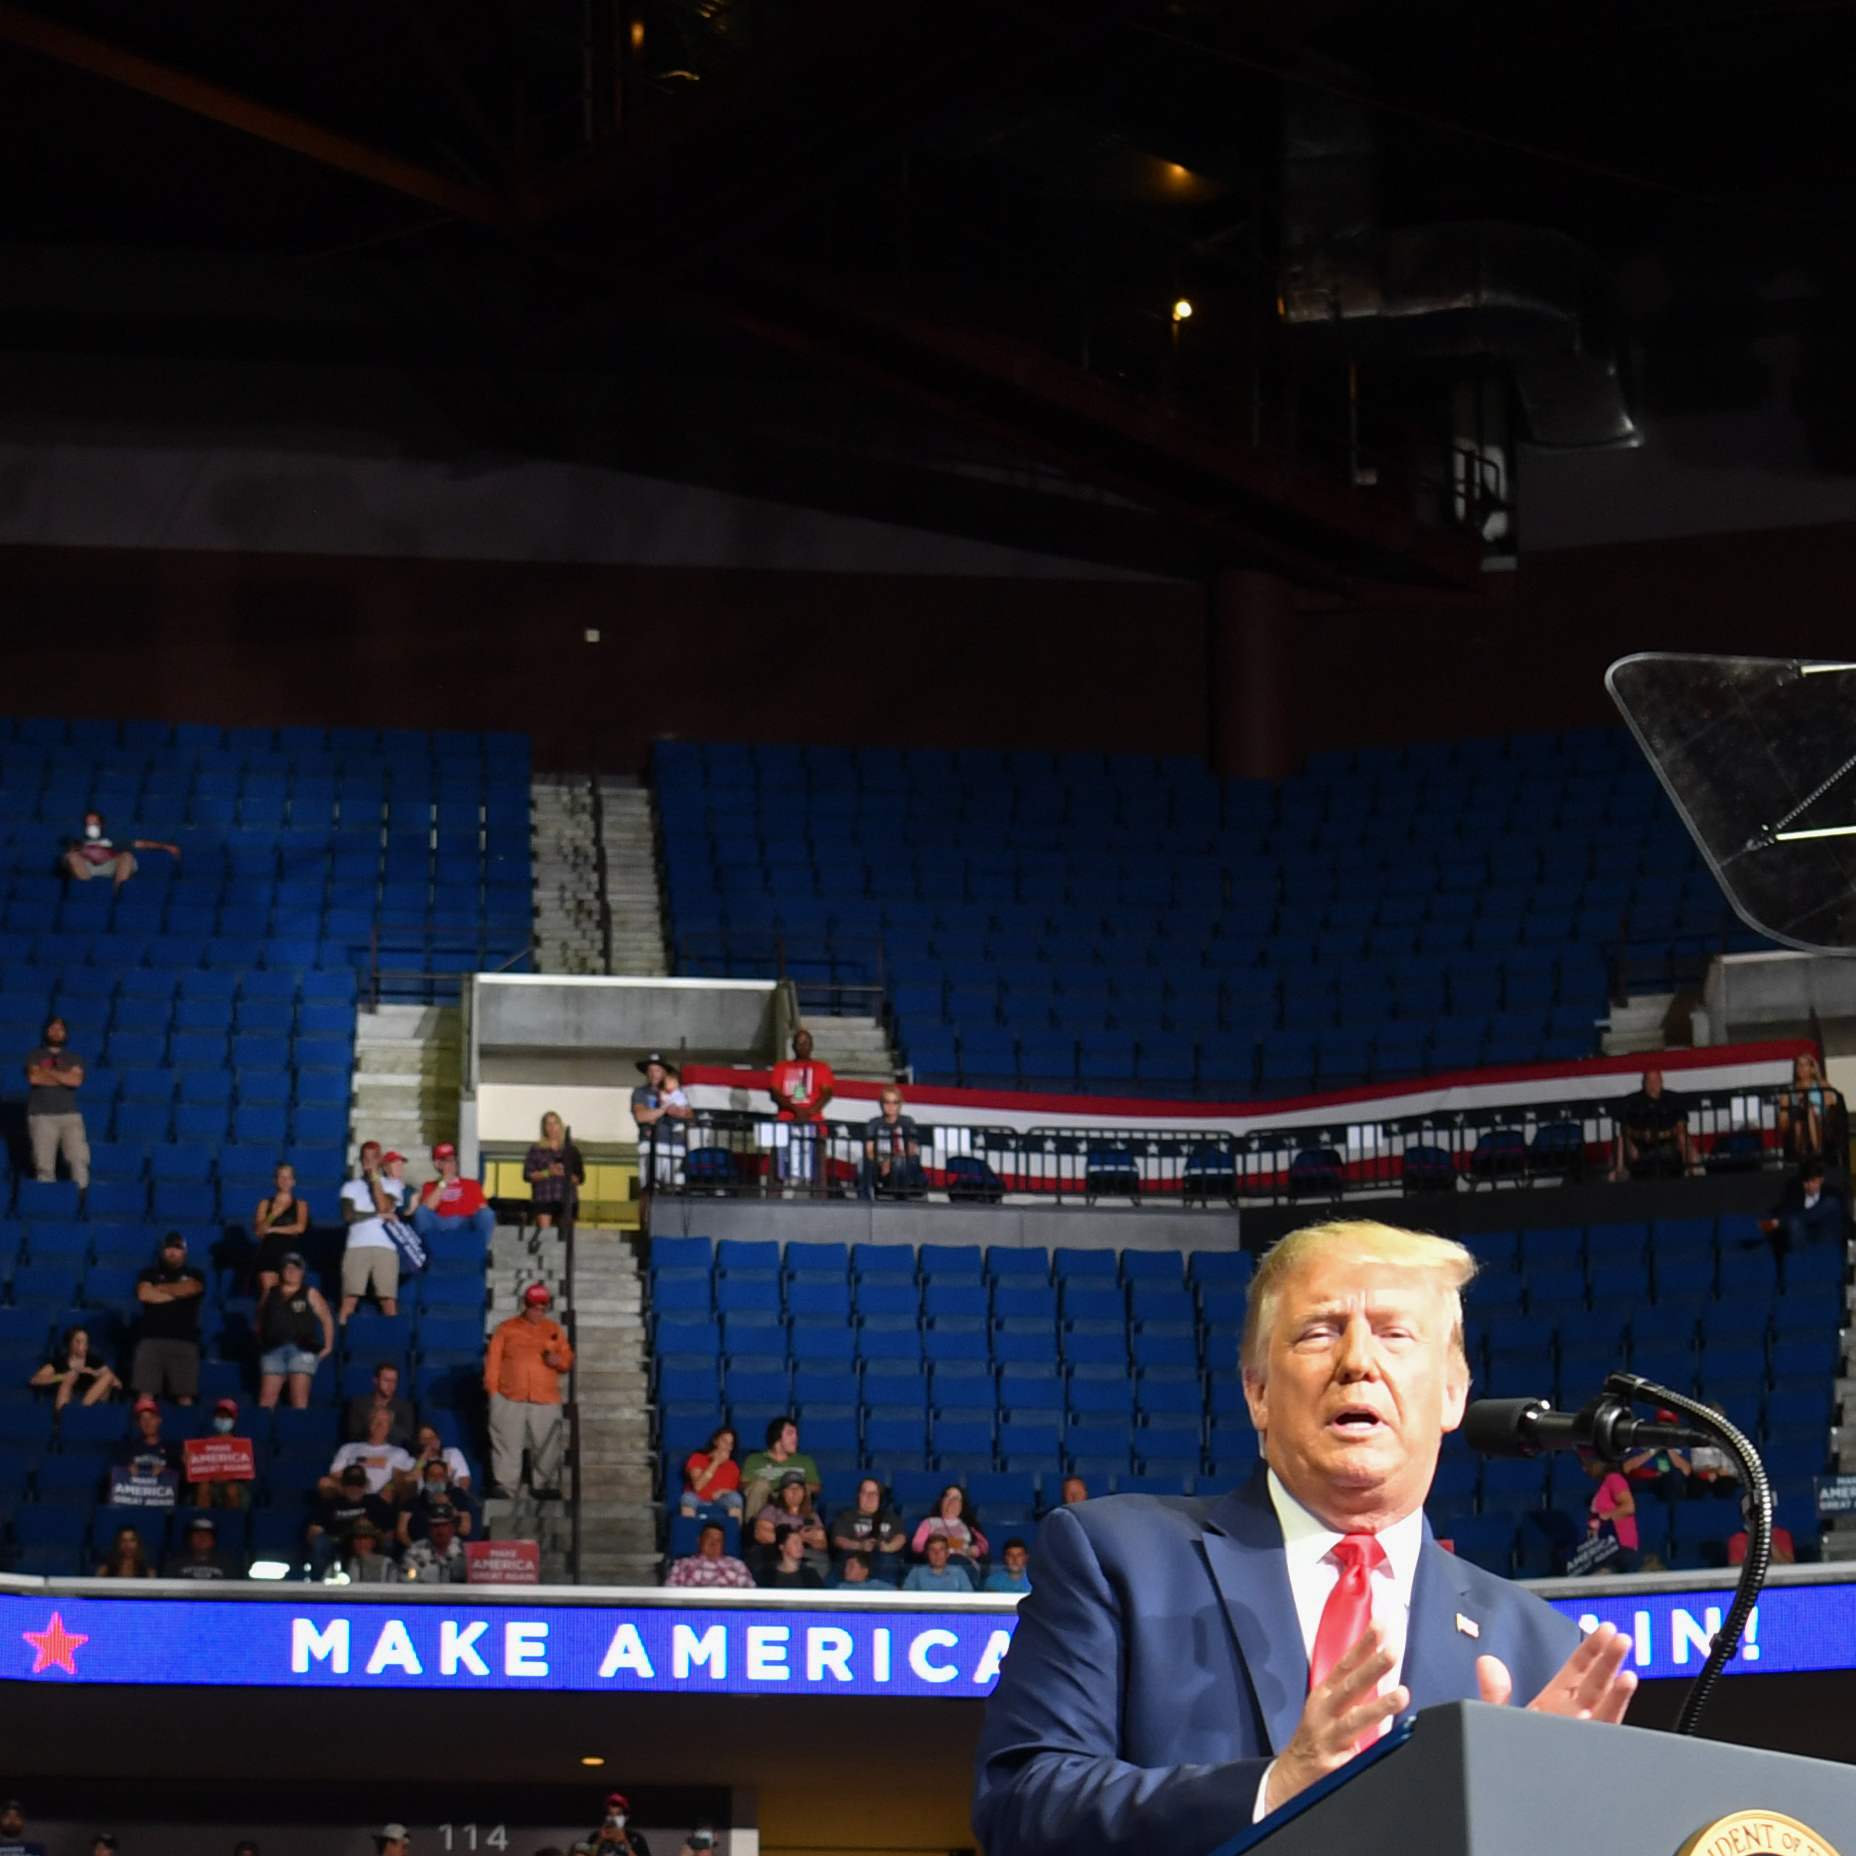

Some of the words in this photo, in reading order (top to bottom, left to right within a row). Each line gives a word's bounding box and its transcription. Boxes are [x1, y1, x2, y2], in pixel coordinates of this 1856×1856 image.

[113, 1483, 175, 1498] AMERICA
[473, 1558, 535, 1573] AMERICA
[291, 1618, 548, 1677] MAKE
[599, 1622, 1012, 1685] AMERICA
[439, 1824, 508, 1851] 114
